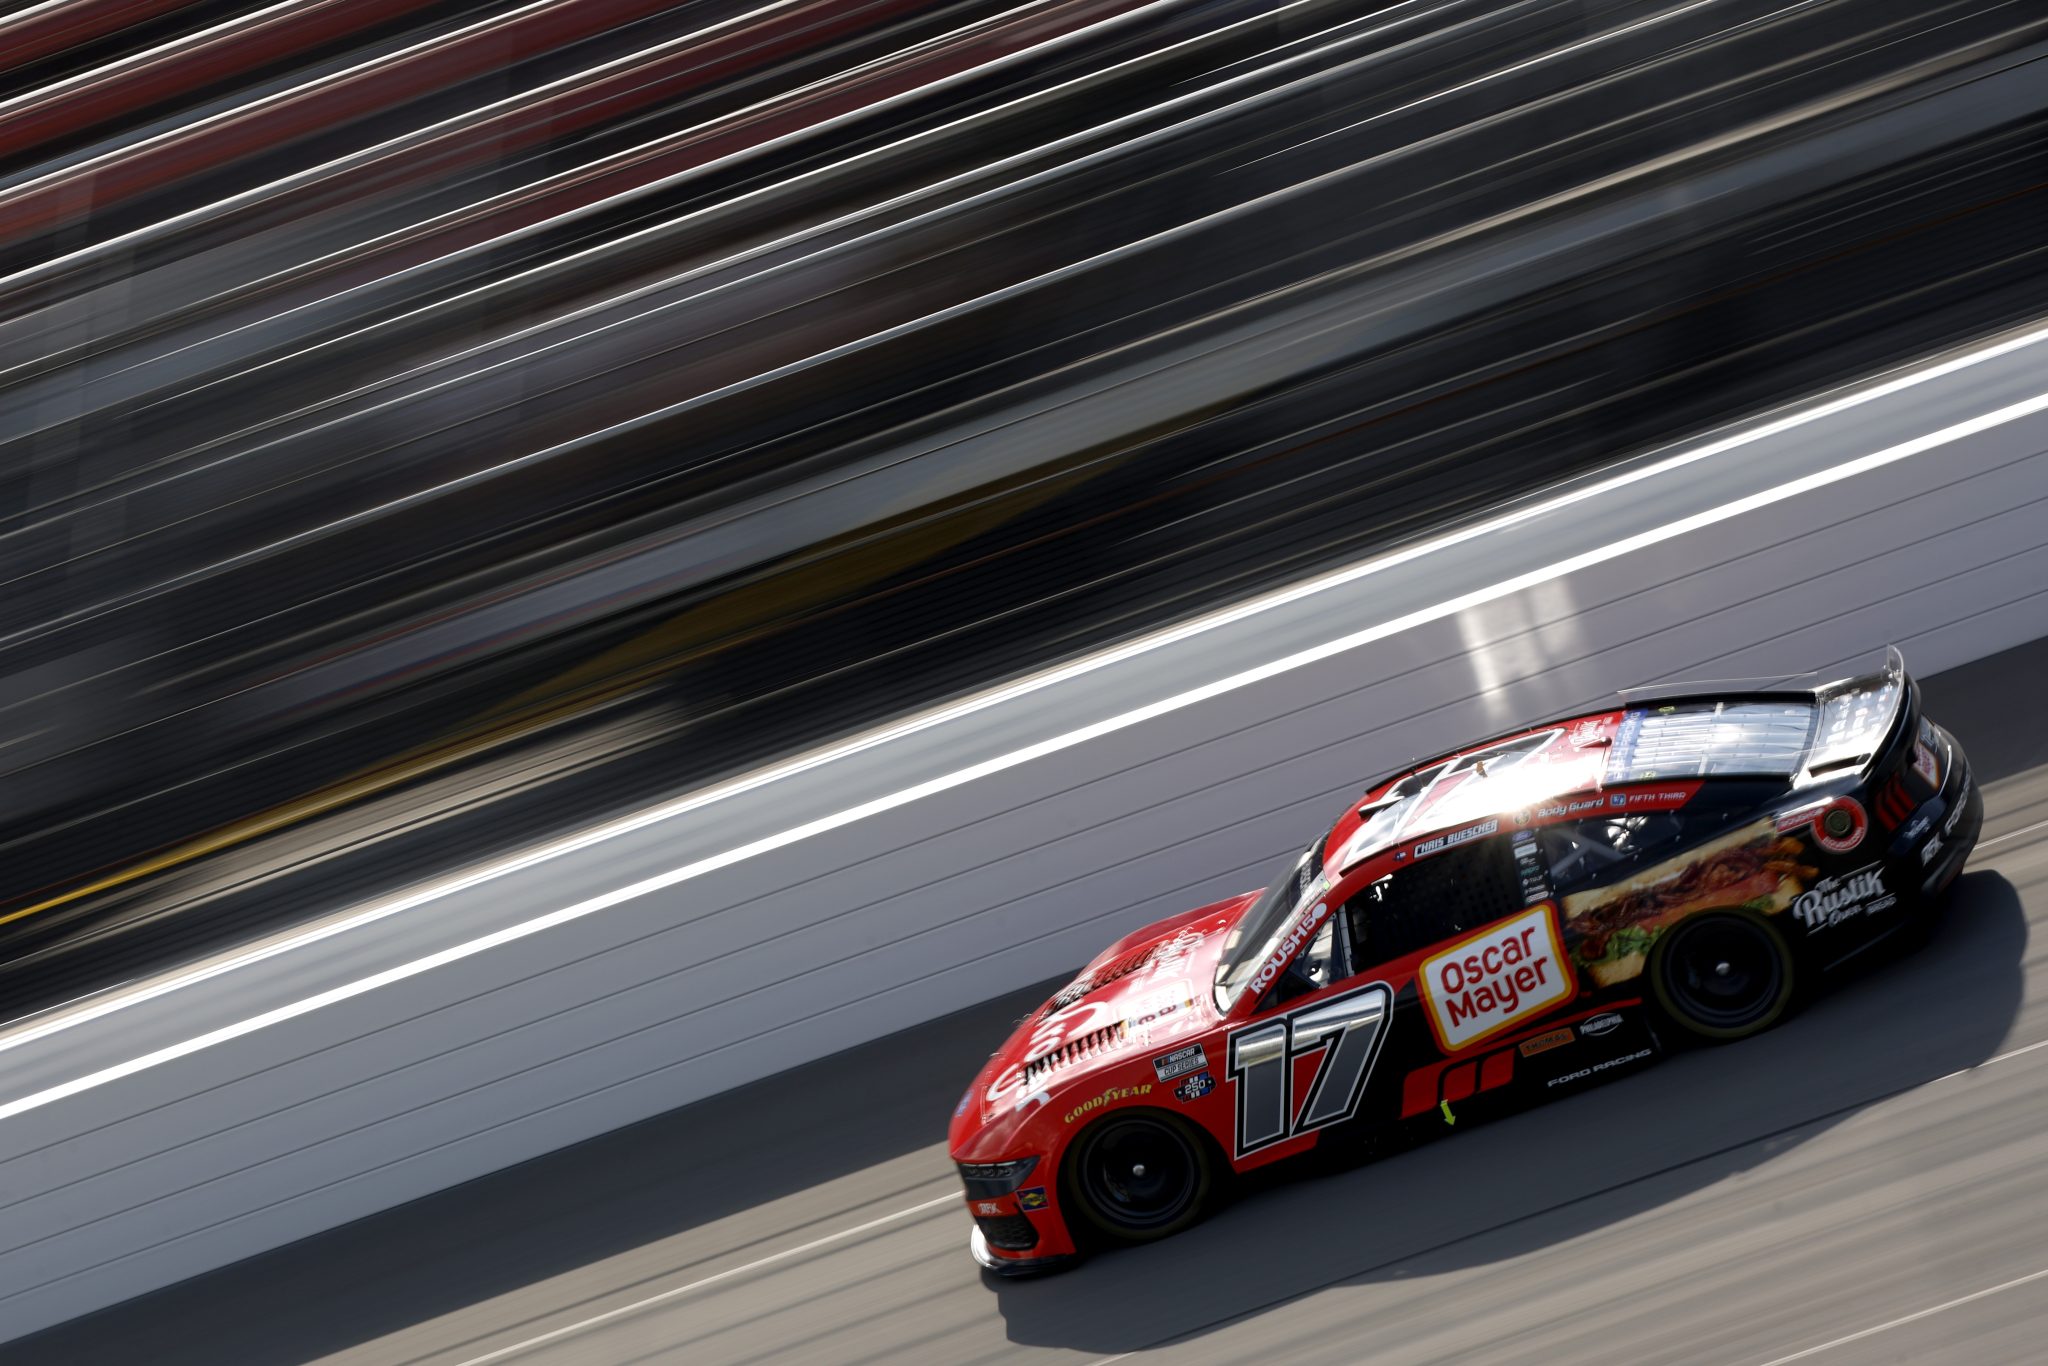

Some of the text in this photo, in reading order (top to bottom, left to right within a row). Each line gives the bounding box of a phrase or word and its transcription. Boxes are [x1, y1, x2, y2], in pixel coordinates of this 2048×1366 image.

[1537, 803, 1567, 818] Body
[1569, 797, 1605, 811] Guard
[1629, 793, 1656, 802] FIFTH
[1658, 791, 1687, 801] THIRD
[1414, 819, 1498, 858] CHRIS BUESCHER
[1441, 926, 1536, 993] Oscar
[1446, 956, 1547, 1027] Mayer
[1164, 1057, 1199, 1076] CUP SERIES
[1169, 1047, 1195, 1063] NASCAR
[1226, 980, 1395, 1161] 17
[1547, 1048, 1652, 1087] FORD RACING
[1064, 1084, 1152, 1124] GOODYEAR
[1184, 1079, 1206, 1095] 250
